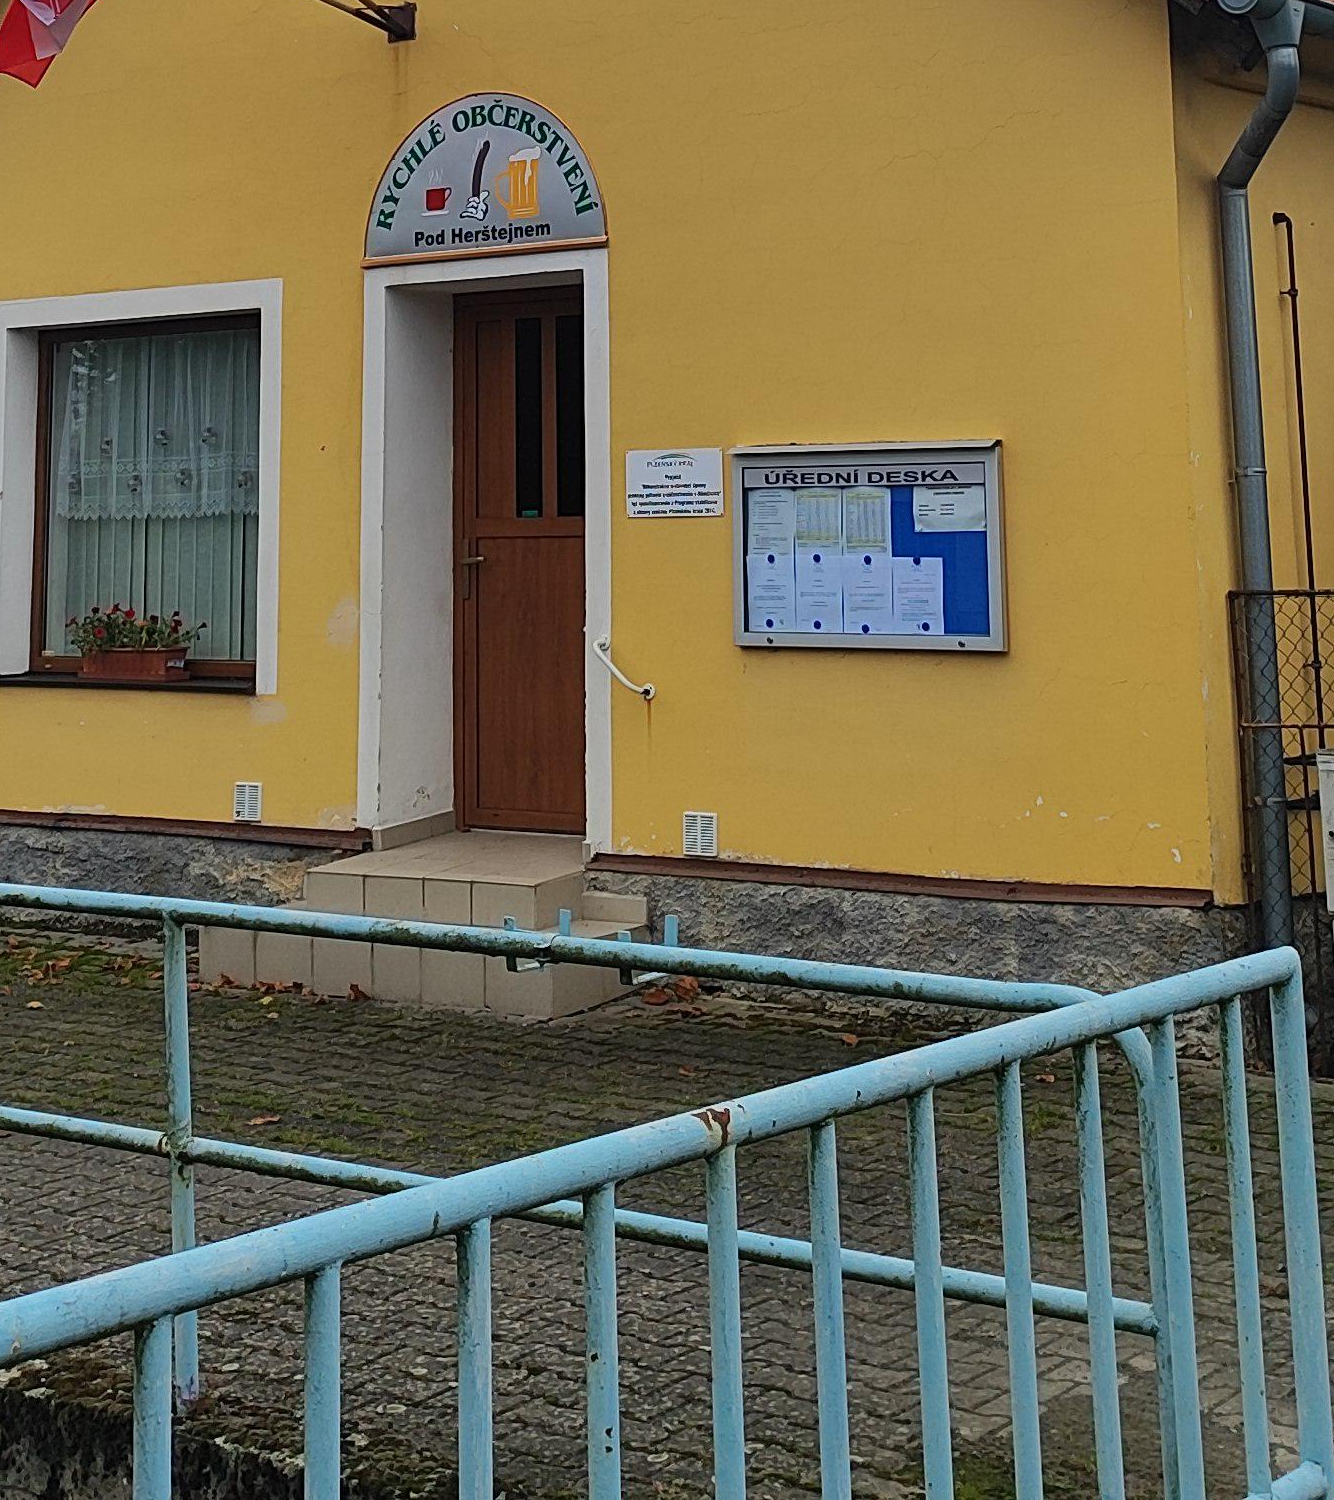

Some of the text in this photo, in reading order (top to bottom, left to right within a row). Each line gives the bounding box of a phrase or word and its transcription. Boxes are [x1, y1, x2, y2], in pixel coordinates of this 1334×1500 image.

[376, 100, 599, 231] RYCHLÉ OBČERSTVENÍ
[414, 223, 551, 247] Pod Herštejnem
[764, 469, 959, 485] ÚŘEDNÍ DESKA
